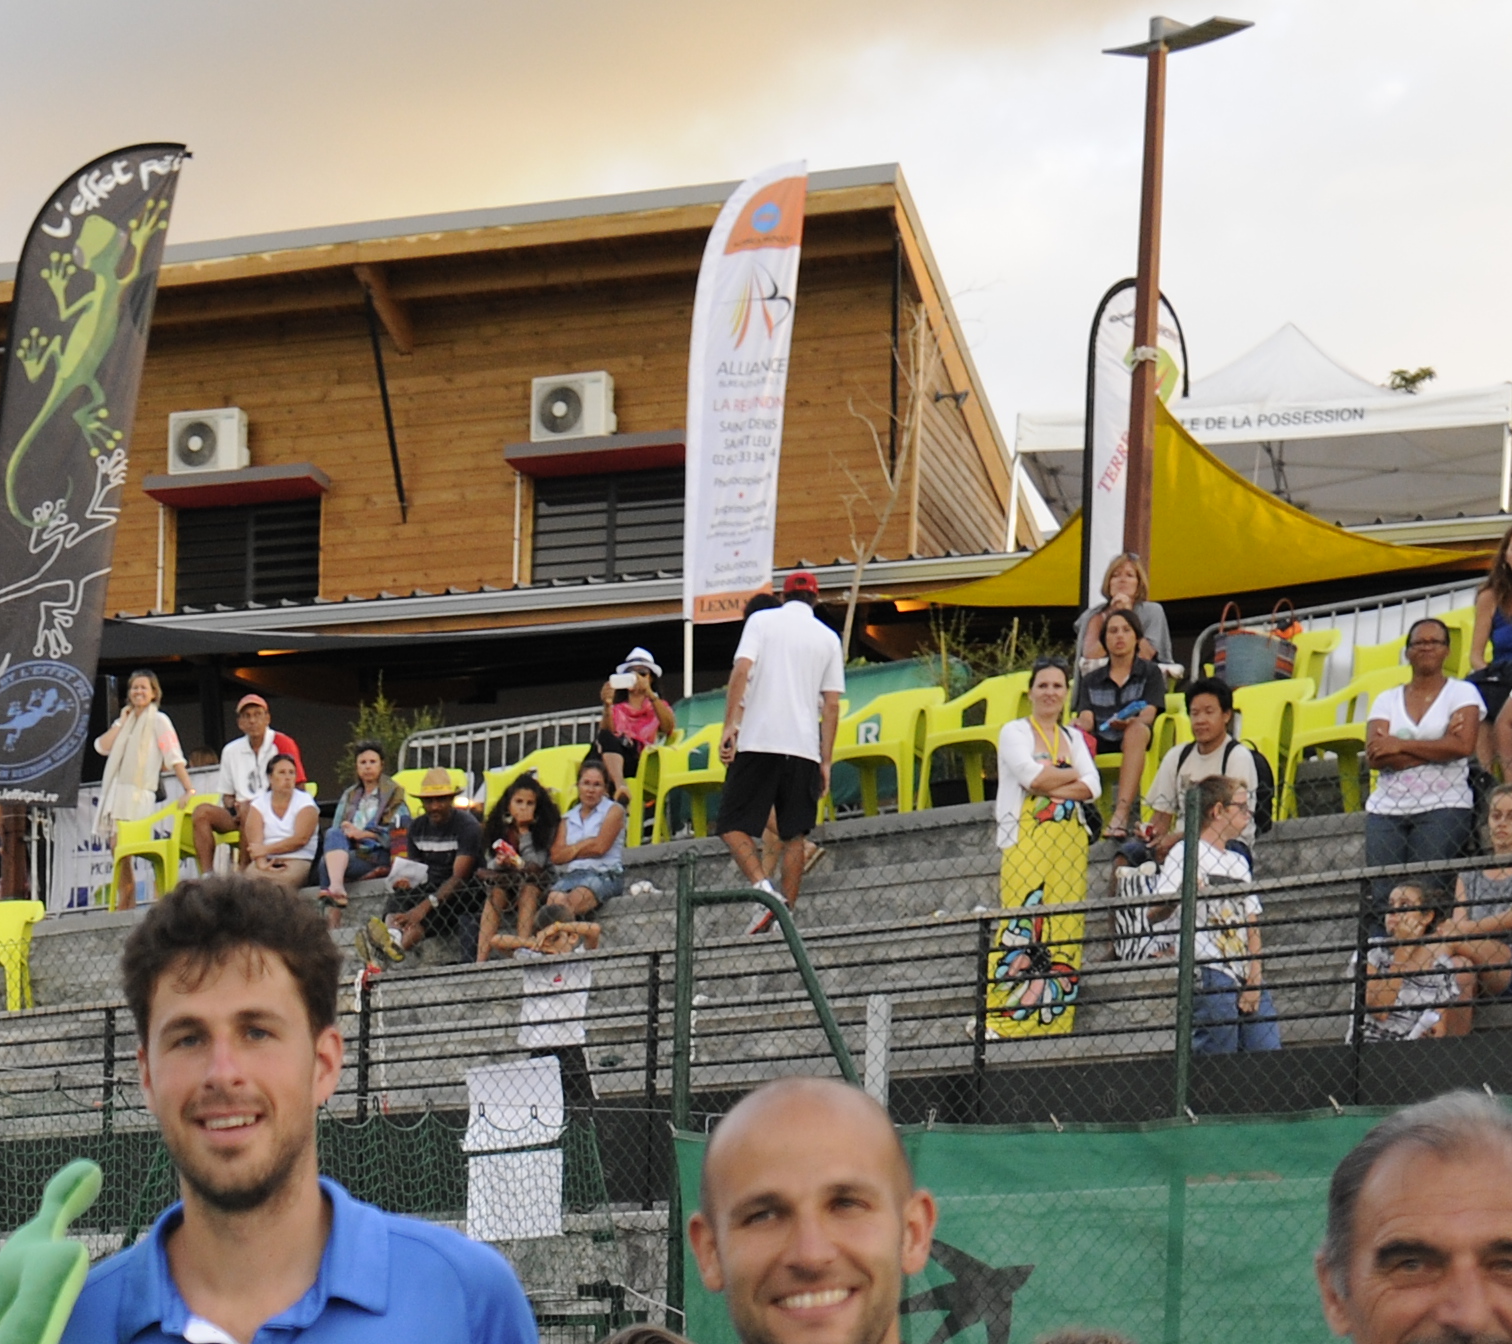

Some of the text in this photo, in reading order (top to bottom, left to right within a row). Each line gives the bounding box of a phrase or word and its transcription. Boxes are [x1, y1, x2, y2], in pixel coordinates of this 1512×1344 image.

[716, 357, 786, 375] ALLIANCE
[1205, 416, 1226, 430] DE
[1232, 414, 1252, 428] LA
[1257, 407, 1365, 427] POSSESSION
